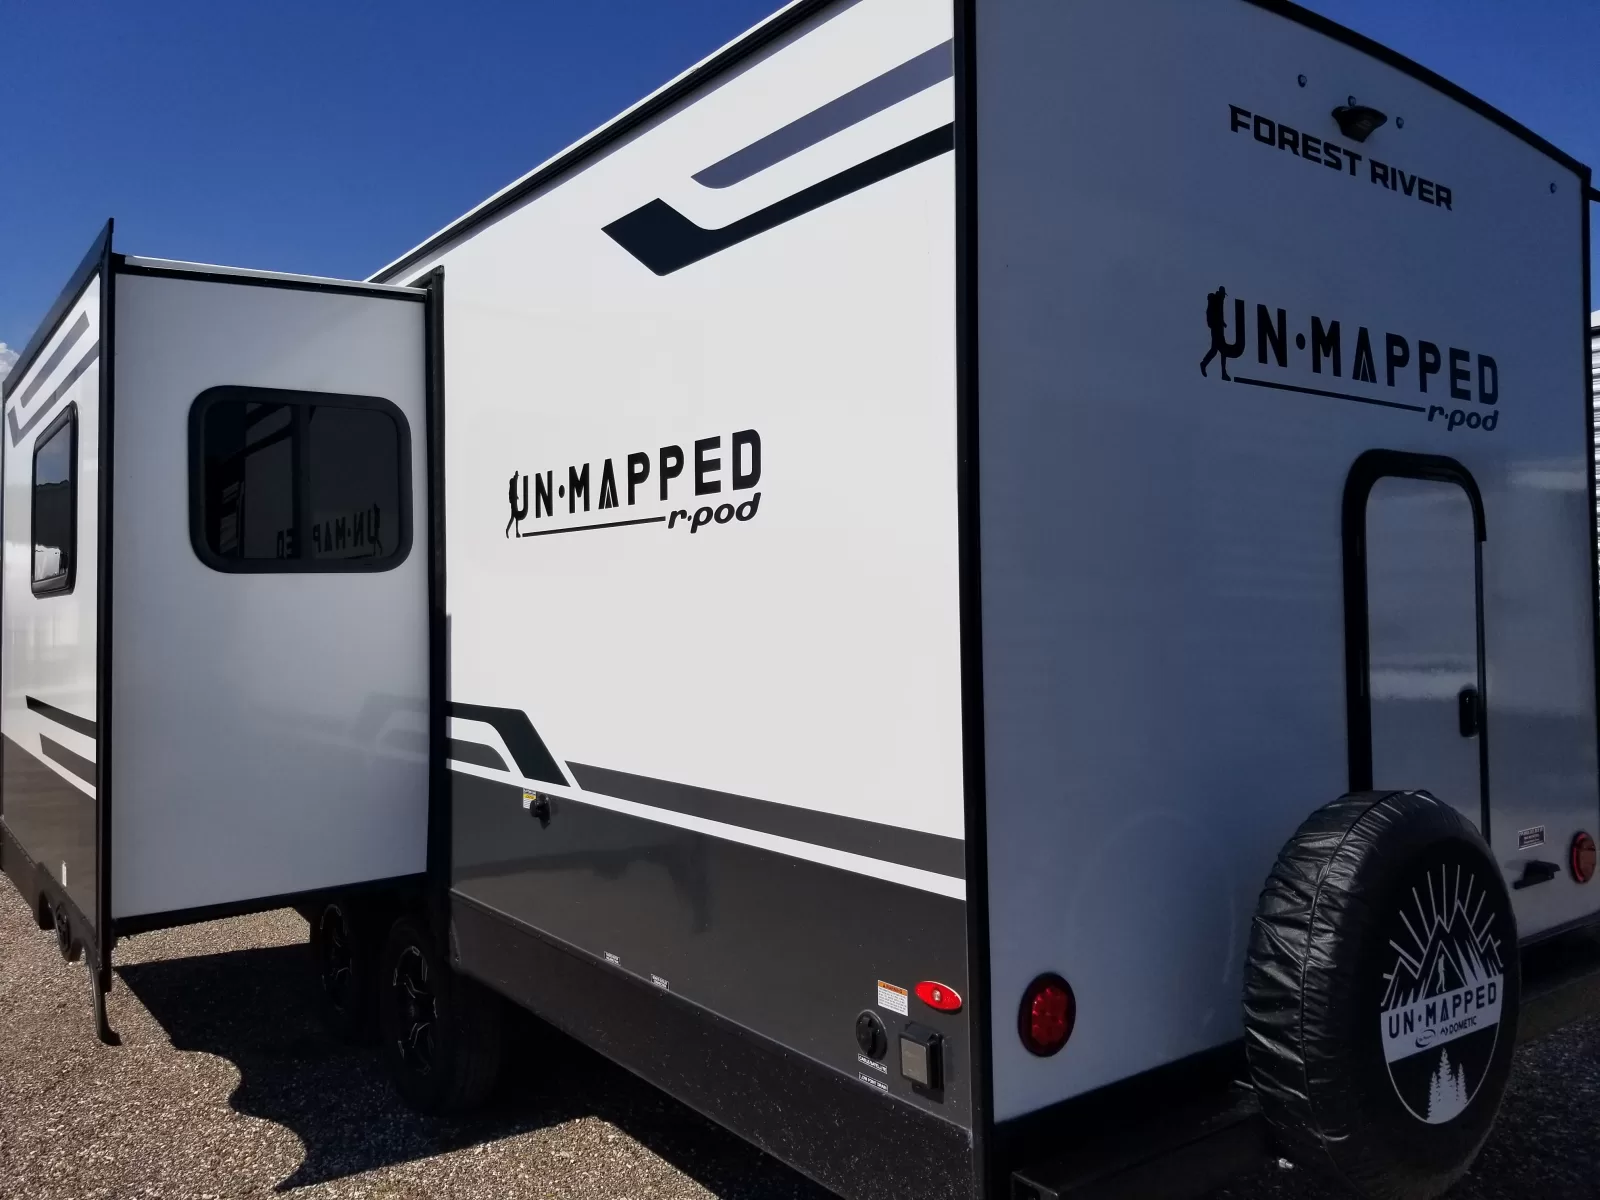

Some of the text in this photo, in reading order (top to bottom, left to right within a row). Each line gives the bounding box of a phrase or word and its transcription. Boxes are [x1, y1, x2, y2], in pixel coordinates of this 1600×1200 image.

[1229, 104, 1453, 211] FOREST RIVER
[1449, 1015, 1477, 1035] DOMETIC
